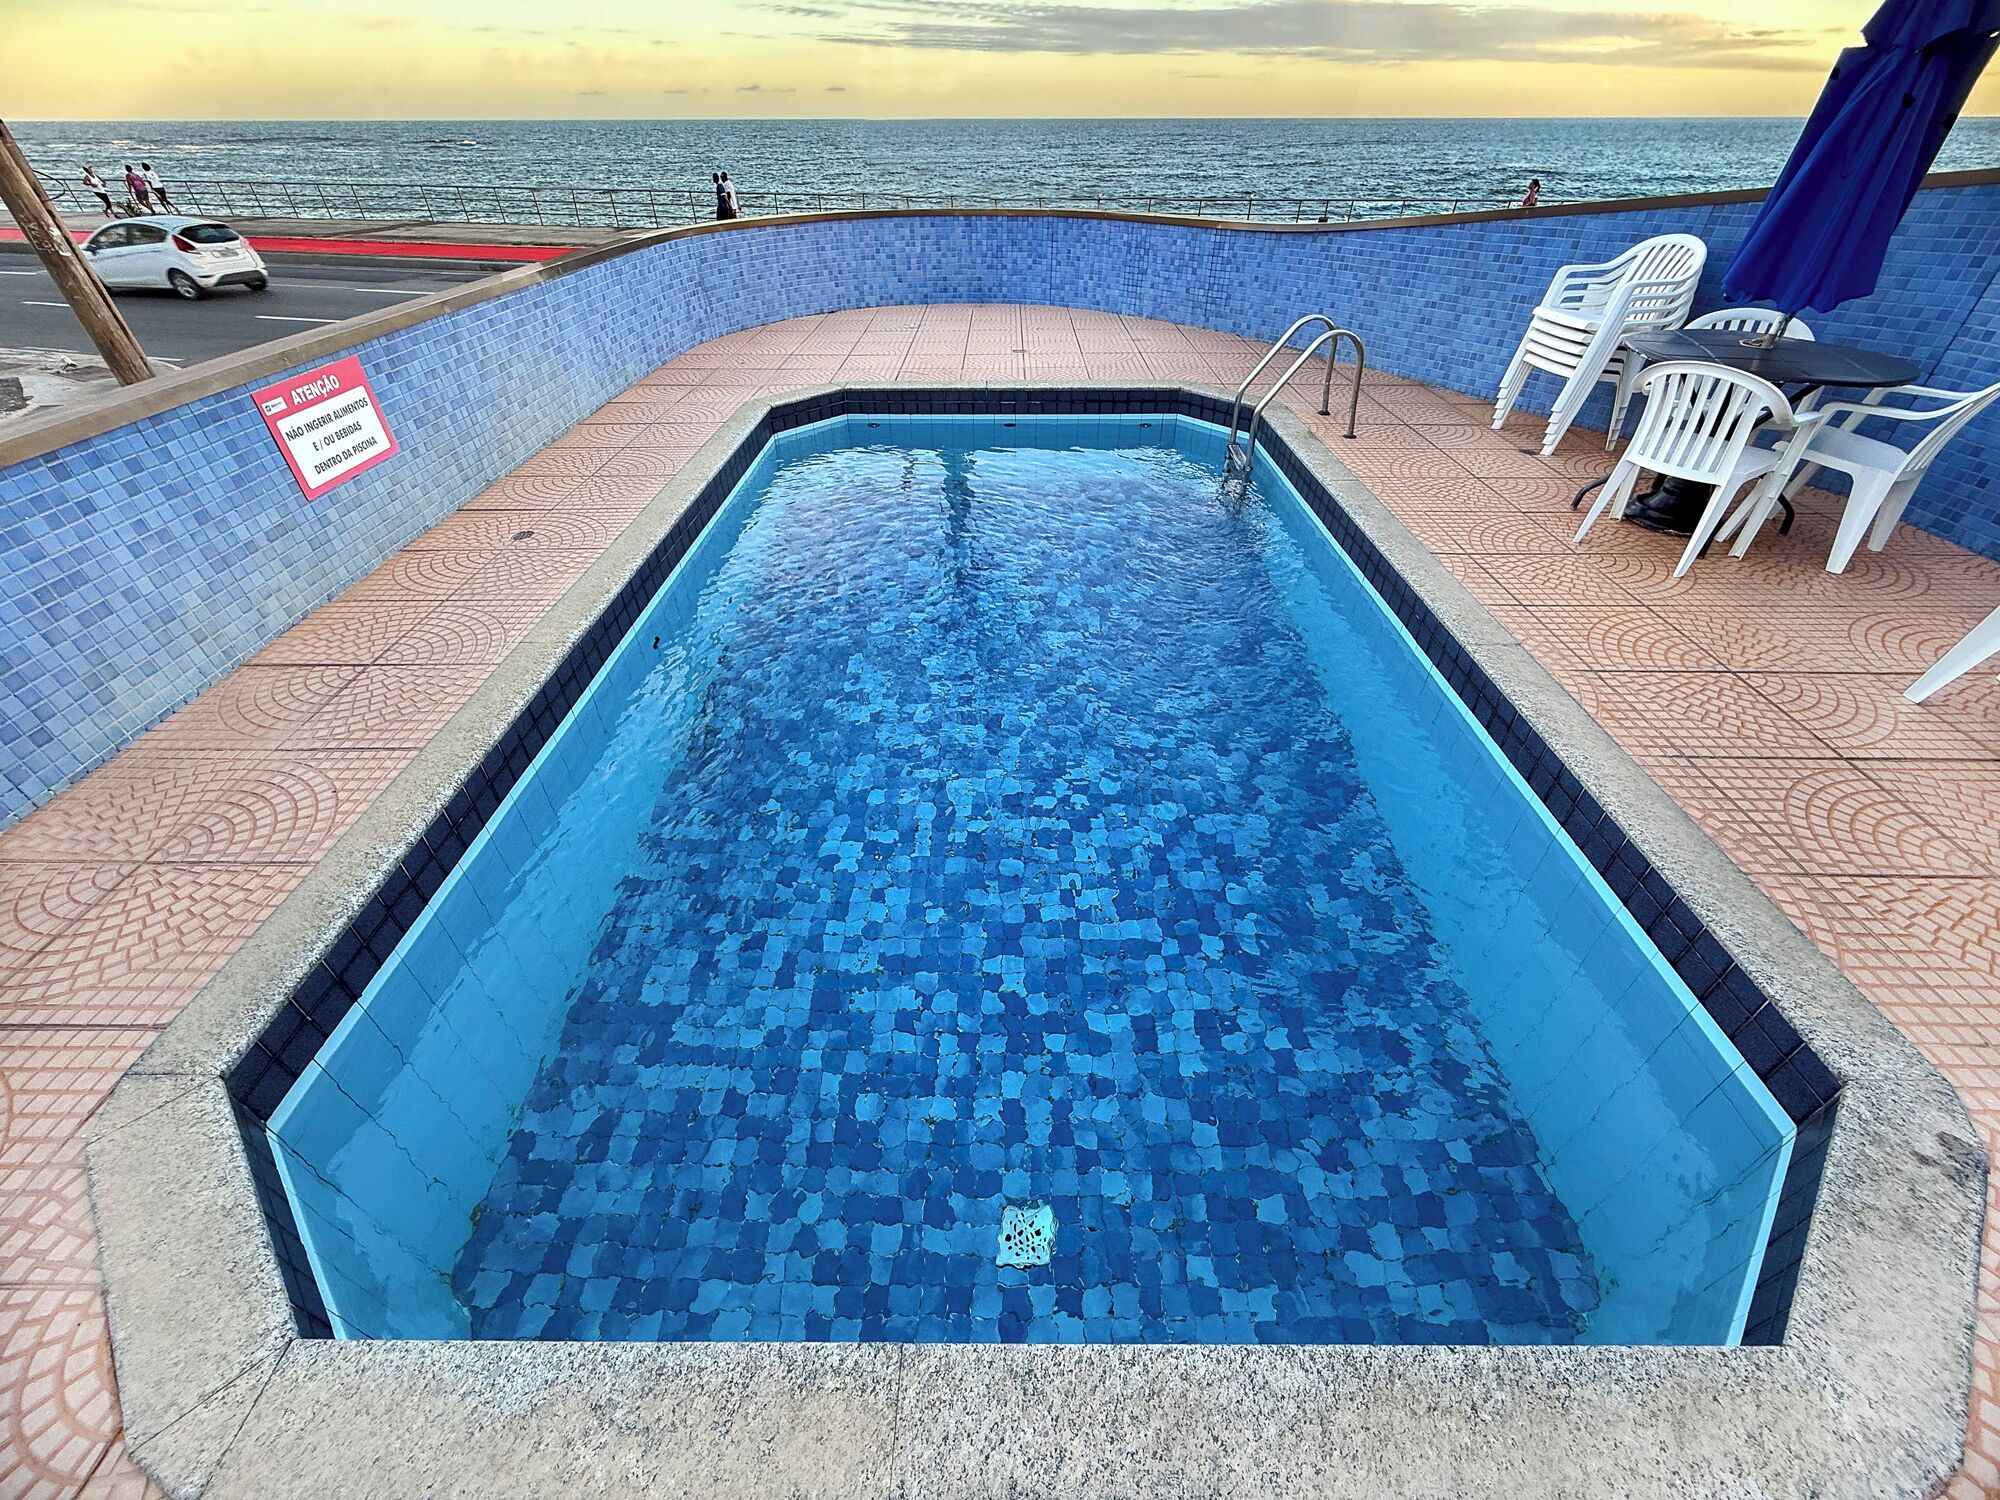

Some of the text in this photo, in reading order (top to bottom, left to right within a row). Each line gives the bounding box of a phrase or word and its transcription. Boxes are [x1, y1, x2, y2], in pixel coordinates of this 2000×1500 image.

[291, 374, 340, 405] ATENÇÃO
[285, 397, 368, 441] NÃO INGERIR ALIMENTOS
[312, 441, 320, 451] E
[324, 434, 336, 446] OU
[335, 421, 362, 440] BEBIDAS
[314, 436, 378, 474] DENTRO DA PISCINA
